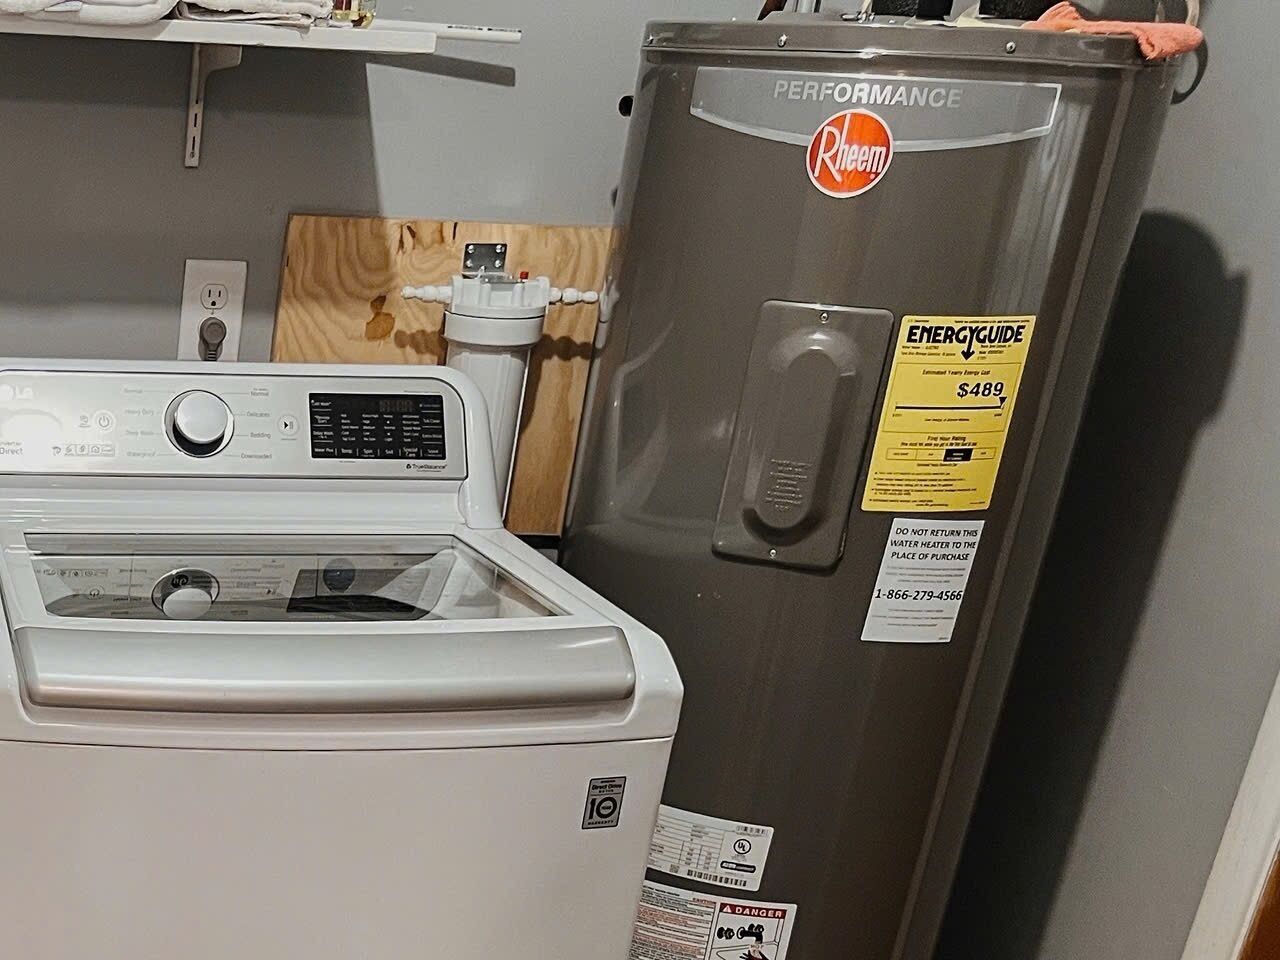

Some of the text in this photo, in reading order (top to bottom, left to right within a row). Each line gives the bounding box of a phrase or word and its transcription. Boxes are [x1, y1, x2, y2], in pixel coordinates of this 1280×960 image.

[774, 79, 965, 109] PERFORMANCE
[814, 113, 887, 183] Rheem
[906, 325, 1026, 345] ENERGYGUIDE
[957, 381, 1004, 399] $489
[0, 447, 23, 455] Direct
[895, 527, 978, 537] DO NOT RETURN THIS
[890, 539, 977, 549] WATER HEATER TO THE
[891, 551, 970, 561] PLACE OF PURCHASE
[875, 588, 963, 601] 1-866-279-4566
[588, 796, 618, 820] 10
[735, 906, 783, 918] DANGER
